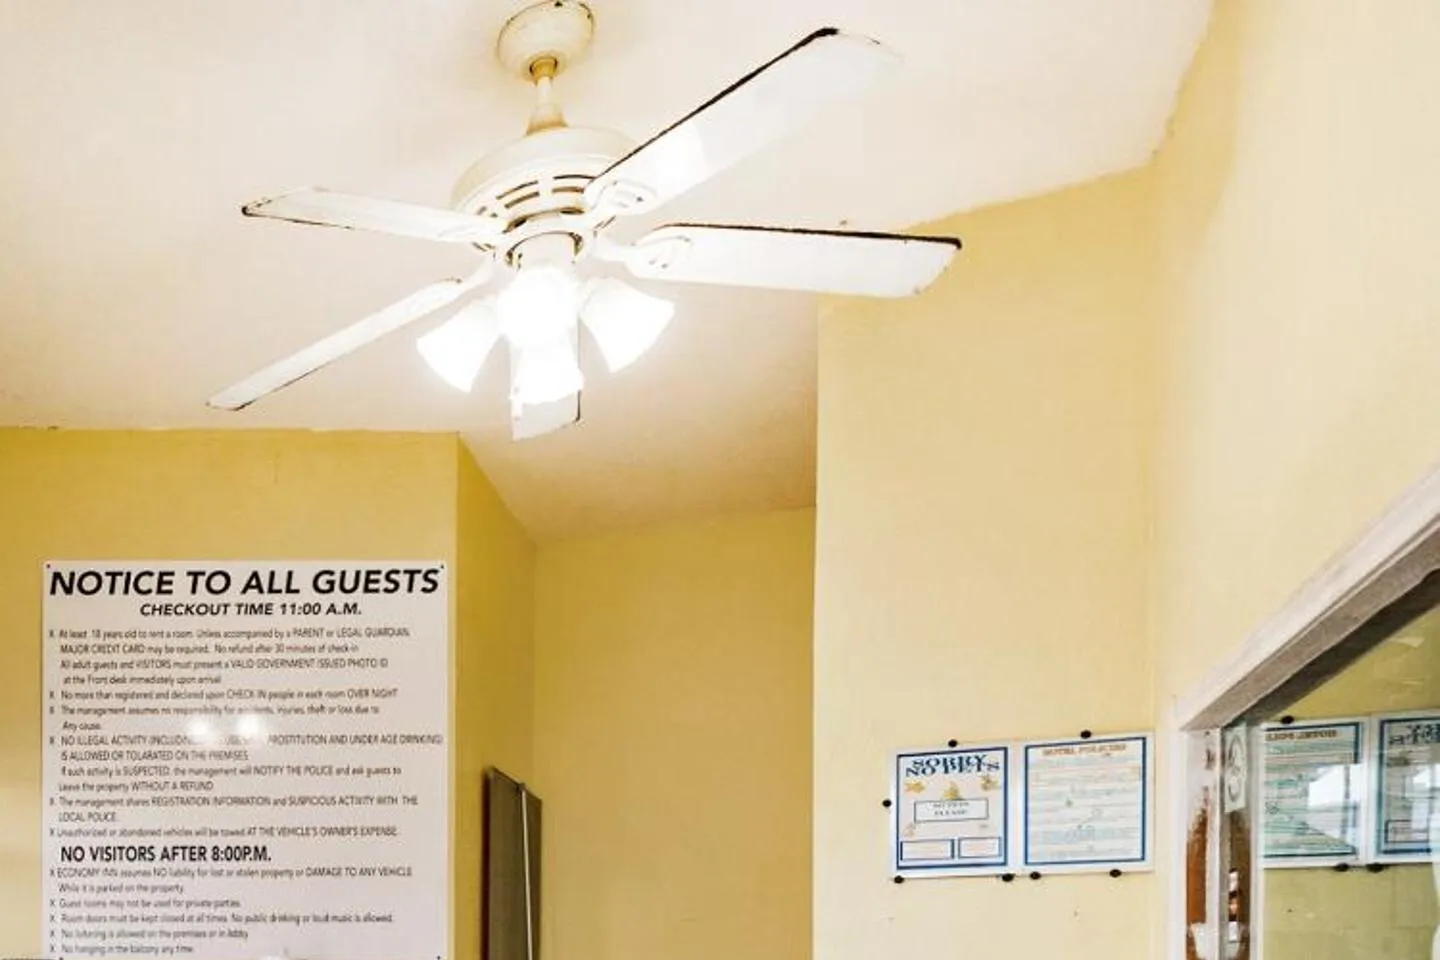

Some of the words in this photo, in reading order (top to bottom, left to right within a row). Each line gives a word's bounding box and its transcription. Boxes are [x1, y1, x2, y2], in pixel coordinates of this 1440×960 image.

[49, 571, 175, 595] NOTICE
[186, 570, 232, 594] TO
[241, 570, 300, 594] ALL
[313, 569, 440, 594] GUESTS
[140, 603, 231, 616] CHECKOUT
[235, 603, 274, 616] TIME
[280, 603, 321, 616] 11:00
[326, 603, 362, 616] A.M.
[69, 629, 87, 638] least
[92, 629, 100, 638] 18
[103, 631, 123, 641] years
[124, 629, 136, 638] old
[274, 629, 284, 640] by
[293, 629, 324, 638] PARENT
[336, 628, 363, 637] LEGAL
[60, 644, 89, 653] MAJOR
[91, 644, 120, 653] CREDIT
[122, 644, 145, 653] CARD
[147, 646, 163, 656] may
[165, 644, 175, 653] be
[214, 644, 227, 653] No
[228, 644, 253, 653] refund
[275, 644, 284, 653] 30
[286, 644, 316, 653] minutes
[72, 660, 91, 669] adult
[93, 660, 118, 671] guests
[120, 660, 134, 669] and
[136, 659, 172, 669] VISITORS
[193, 659, 223, 671] present
[231, 659, 254, 669] VALID
[256, 659, 315, 668] GOVERNMENT
[317, 659, 346, 668] ISSUED
[347, 659, 377, 668] PHOTO
[109, 675, 127, 684] desk
[129, 675, 175, 686] immediately
[61, 690, 73, 699] No
[96, 690, 113, 699] than
[115, 690, 153, 701] registered
[155, 690, 170, 699] and
[171, 690, 204, 699] declared
[227, 690, 255, 699] CHECK
[268, 689, 295, 701] people
[347, 689, 369, 698] OVER
[372, 689, 398, 698] NIGHT
[77, 706, 126, 717] management
[62, 721, 77, 732] Any
[61, 735, 75, 745] NO
[77, 735, 109, 745] ILLEGAL
[111, 735, 148, 745] ACTIVITY
[329, 734, 348, 744] AND
[349, 734, 379, 744] UNDER
[380, 734, 398, 744] AGE
[70, 751, 110, 760] ALLOWED
[111, 751, 124, 760] OR
[175, 751, 189, 760] ON
[190, 751, 206, 760] THE
[188, 766, 237, 778] management
[253, 766, 284, 776] NOTIFY
[286, 766, 302, 776] THE
[304, 766, 334, 776] POLICE
[335, 766, 350, 775] and
[366, 766, 391, 778] guests
[96, 781, 129, 793] property
[131, 781, 170, 791] WITHOUT
[59, 797, 73, 806] The
[74, 797, 124, 809] management
[151, 797, 210, 806] REGISTRATION
[213, 797, 271, 806] INFORMATION
[288, 796, 336, 806] SUSPICIOUS
[338, 796, 374, 806] ACTIVITY
[376, 796, 398, 806] WITH
[402, 796, 418, 806] THE
[59, 812, 85, 822] LOCAL
[259, 827, 275, 837] THE
[61, 846, 85, 861] NO
[90, 846, 156, 861] VISITORS
[160, 846, 207, 861] AFTER
[211, 846, 272, 861] 8:00P.M.
[57, 868, 99, 877] ECONOMY
[153, 868, 168, 877] NO
[261, 868, 294, 880] property
[305, 867, 342, 877] DAMAGE
[345, 867, 357, 877] TO
[359, 867, 377, 877] ANY
[59, 898, 81, 907] Guest
